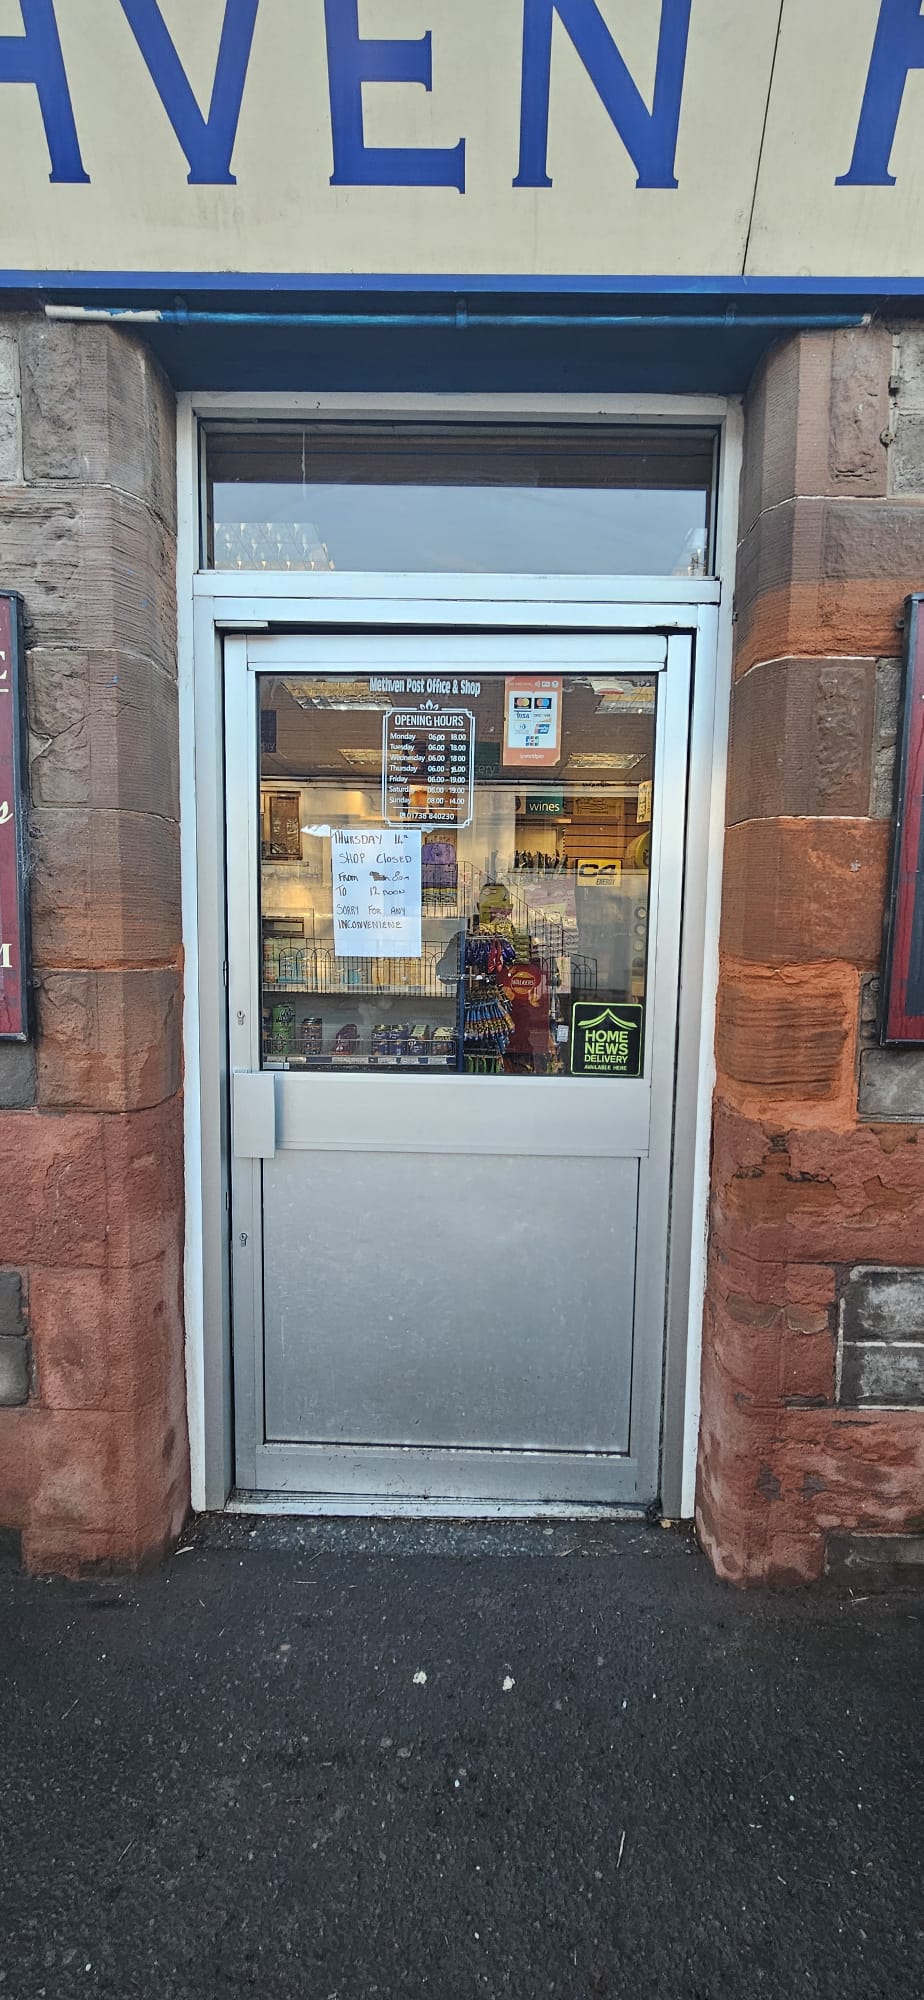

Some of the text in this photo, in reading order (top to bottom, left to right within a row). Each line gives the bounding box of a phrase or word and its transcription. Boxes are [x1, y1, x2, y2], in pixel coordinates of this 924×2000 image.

[369, 677, 481, 697] Methven Post Office & Shop
[394, 714, 464, 727] OPENING HOURS
[389, 733, 416, 741] Monday
[389, 754, 426, 762] Wednesday
[389, 764, 418, 773] Thursday
[389, 775, 408, 783] Friday
[388, 785, 413, 794] Saturd
[388, 796, 412, 804] Sunday
[529, 799, 560, 812] wines
[407, 812, 427, 820] 01738
[339, 851, 366, 864] SHOP
[578, 863, 617, 878] C4
[369, 886, 380, 896] 12
[336, 904, 406, 916] SORRY FOR ANY
[512, 978, 534, 986] WALKERS
[585, 1029, 629, 1043] HOME
[584, 1042, 629, 1056] NEWS
[584, 1054, 628, 1064] DELIVERY
